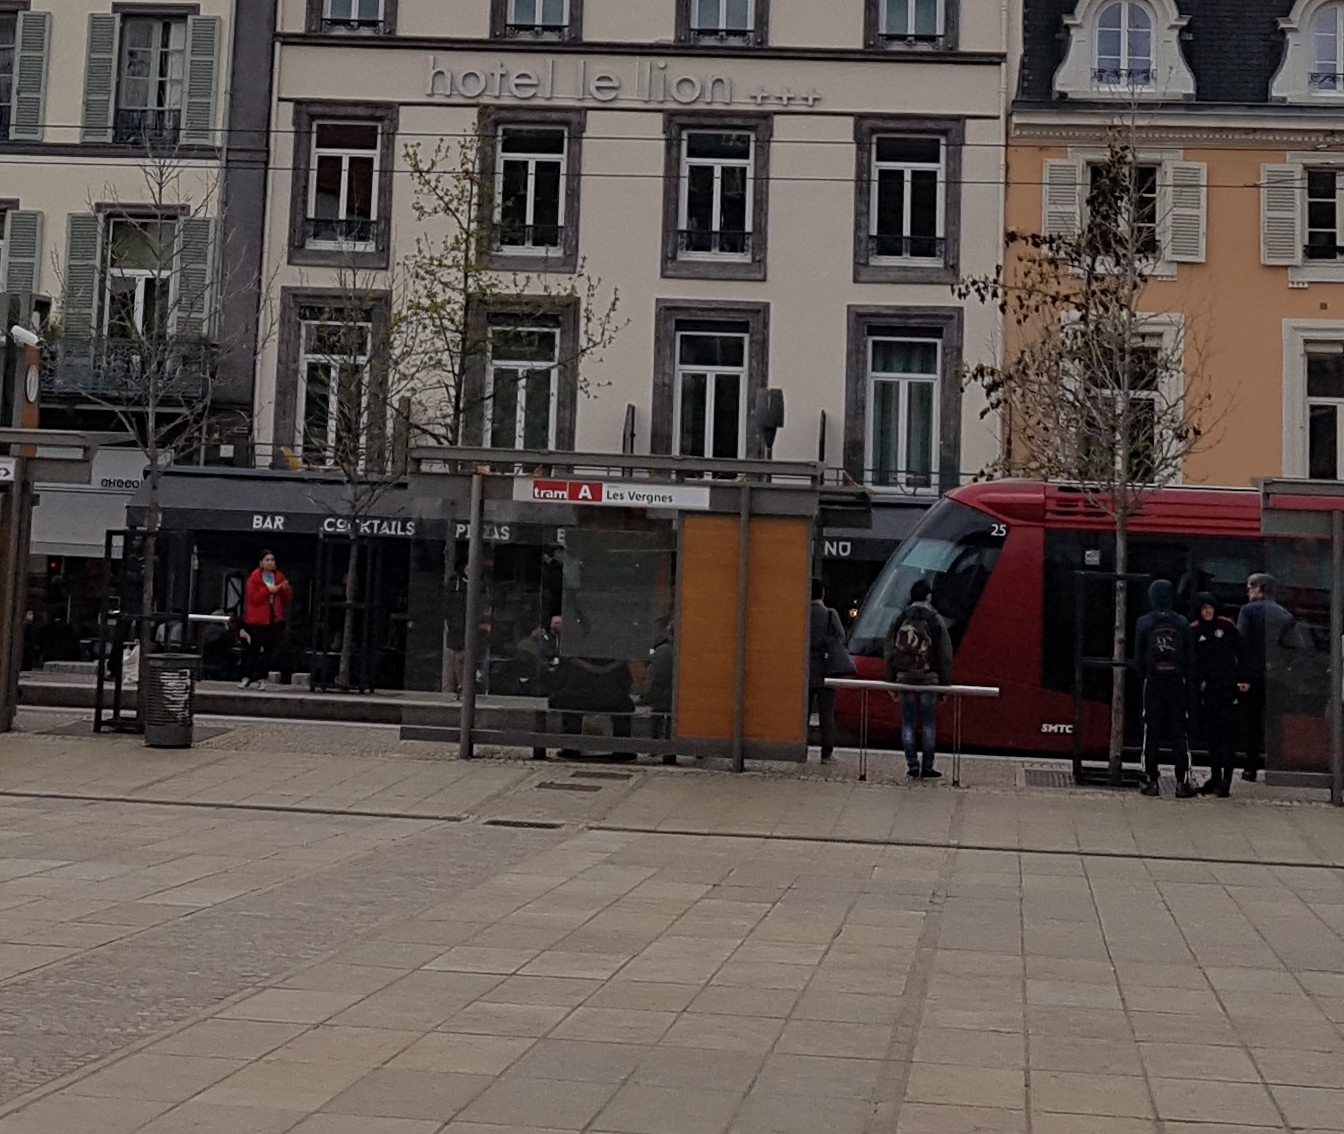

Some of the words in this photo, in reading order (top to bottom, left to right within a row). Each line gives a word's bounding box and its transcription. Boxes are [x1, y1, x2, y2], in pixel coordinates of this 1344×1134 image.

[425, 55, 553, 99] hotel
[577, 59, 620, 102] le
[534, 487, 568, 499] tram
[578, 484, 593, 500] A
[606, 490, 625, 501] Les
[628, 491, 674, 504] Vergnes
[252, 515, 284, 530] BAR
[991, 523, 1007, 537] 25
